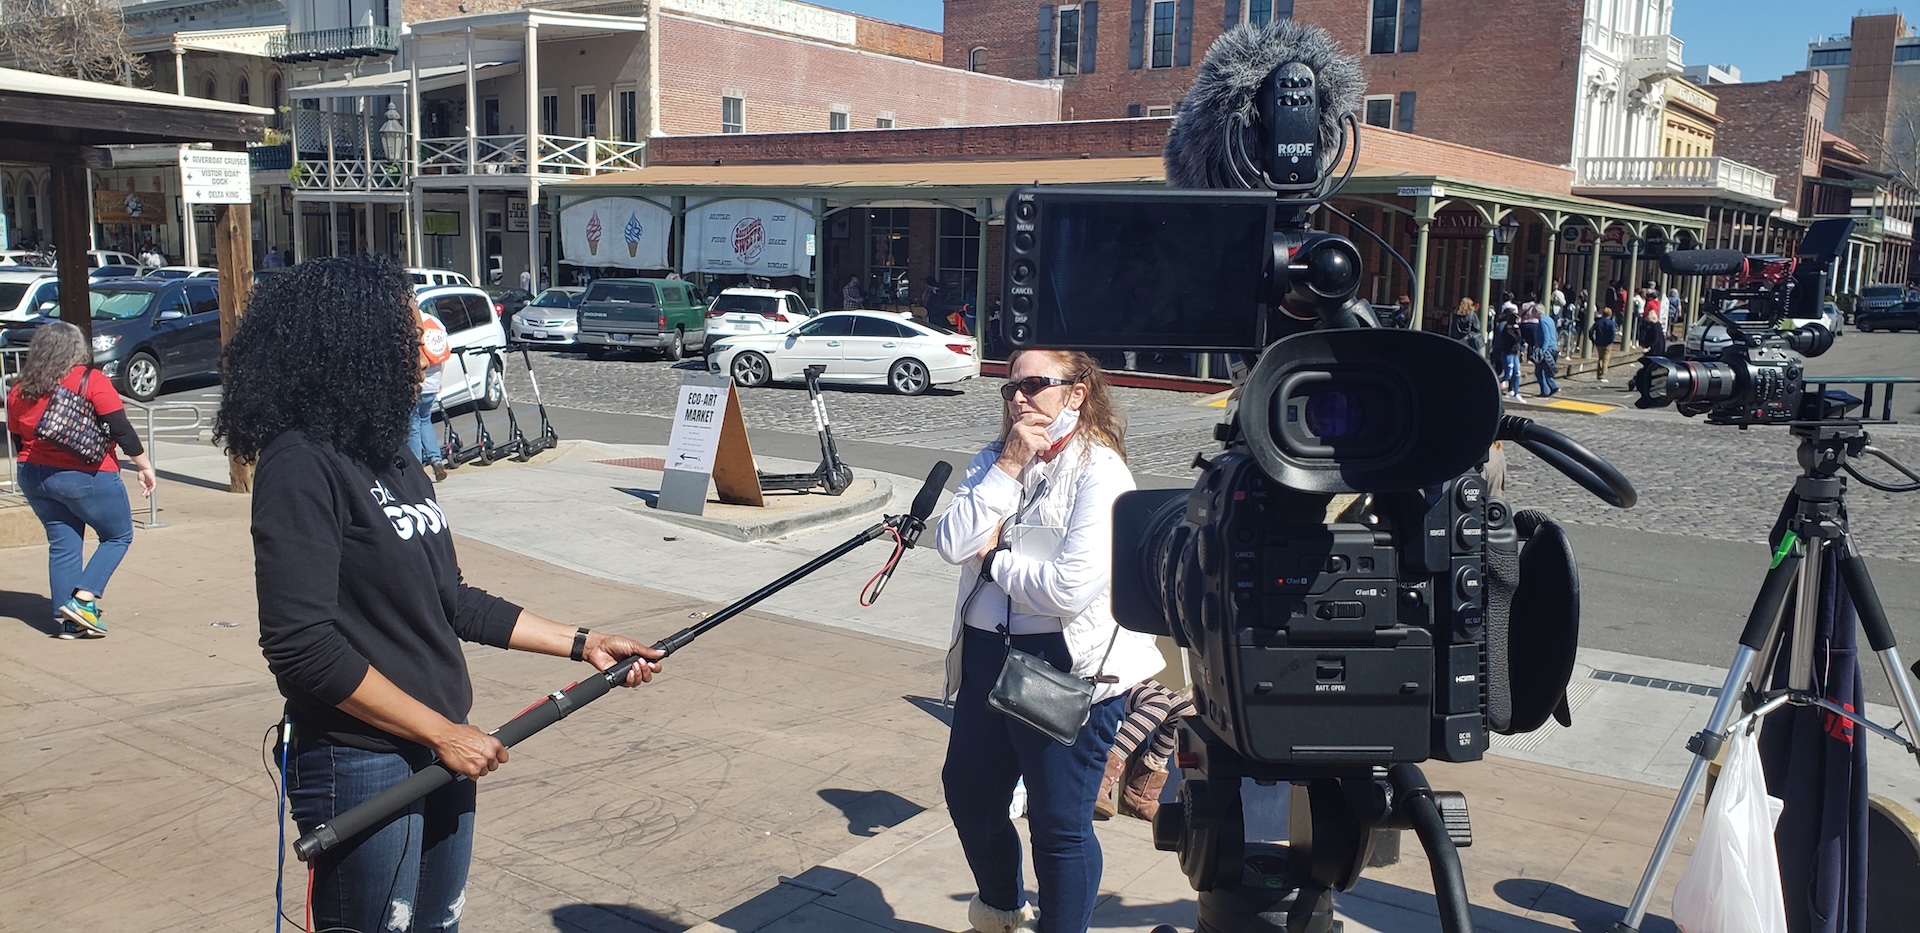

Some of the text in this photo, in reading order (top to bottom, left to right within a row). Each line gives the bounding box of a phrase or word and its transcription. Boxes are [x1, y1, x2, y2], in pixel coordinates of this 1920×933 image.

[1278, 143, 1313, 154] RØDE
[192, 156, 247, 165] RIVERBOAT CRUISES
[224, 170, 240, 178] BOAT
[208, 190, 224, 198] DELTA
[1398, 187, 1420, 195] FRONT
[511, 202, 526, 211] OLD
[1023, 206, 1028, 216] 1
[1011, 287, 1034, 295] CANCEL
[1014, 316, 1028, 324] DISP
[1017, 329, 1024, 338] 2
[687, 392, 718, 407] ECO-ART
[684, 408, 715, 424] MARKET
[1237, 581, 1254, 589] MENU
[1455, 674, 1476, 683] HDMI
[1315, 684, 1346, 692] BATT. OPEN
